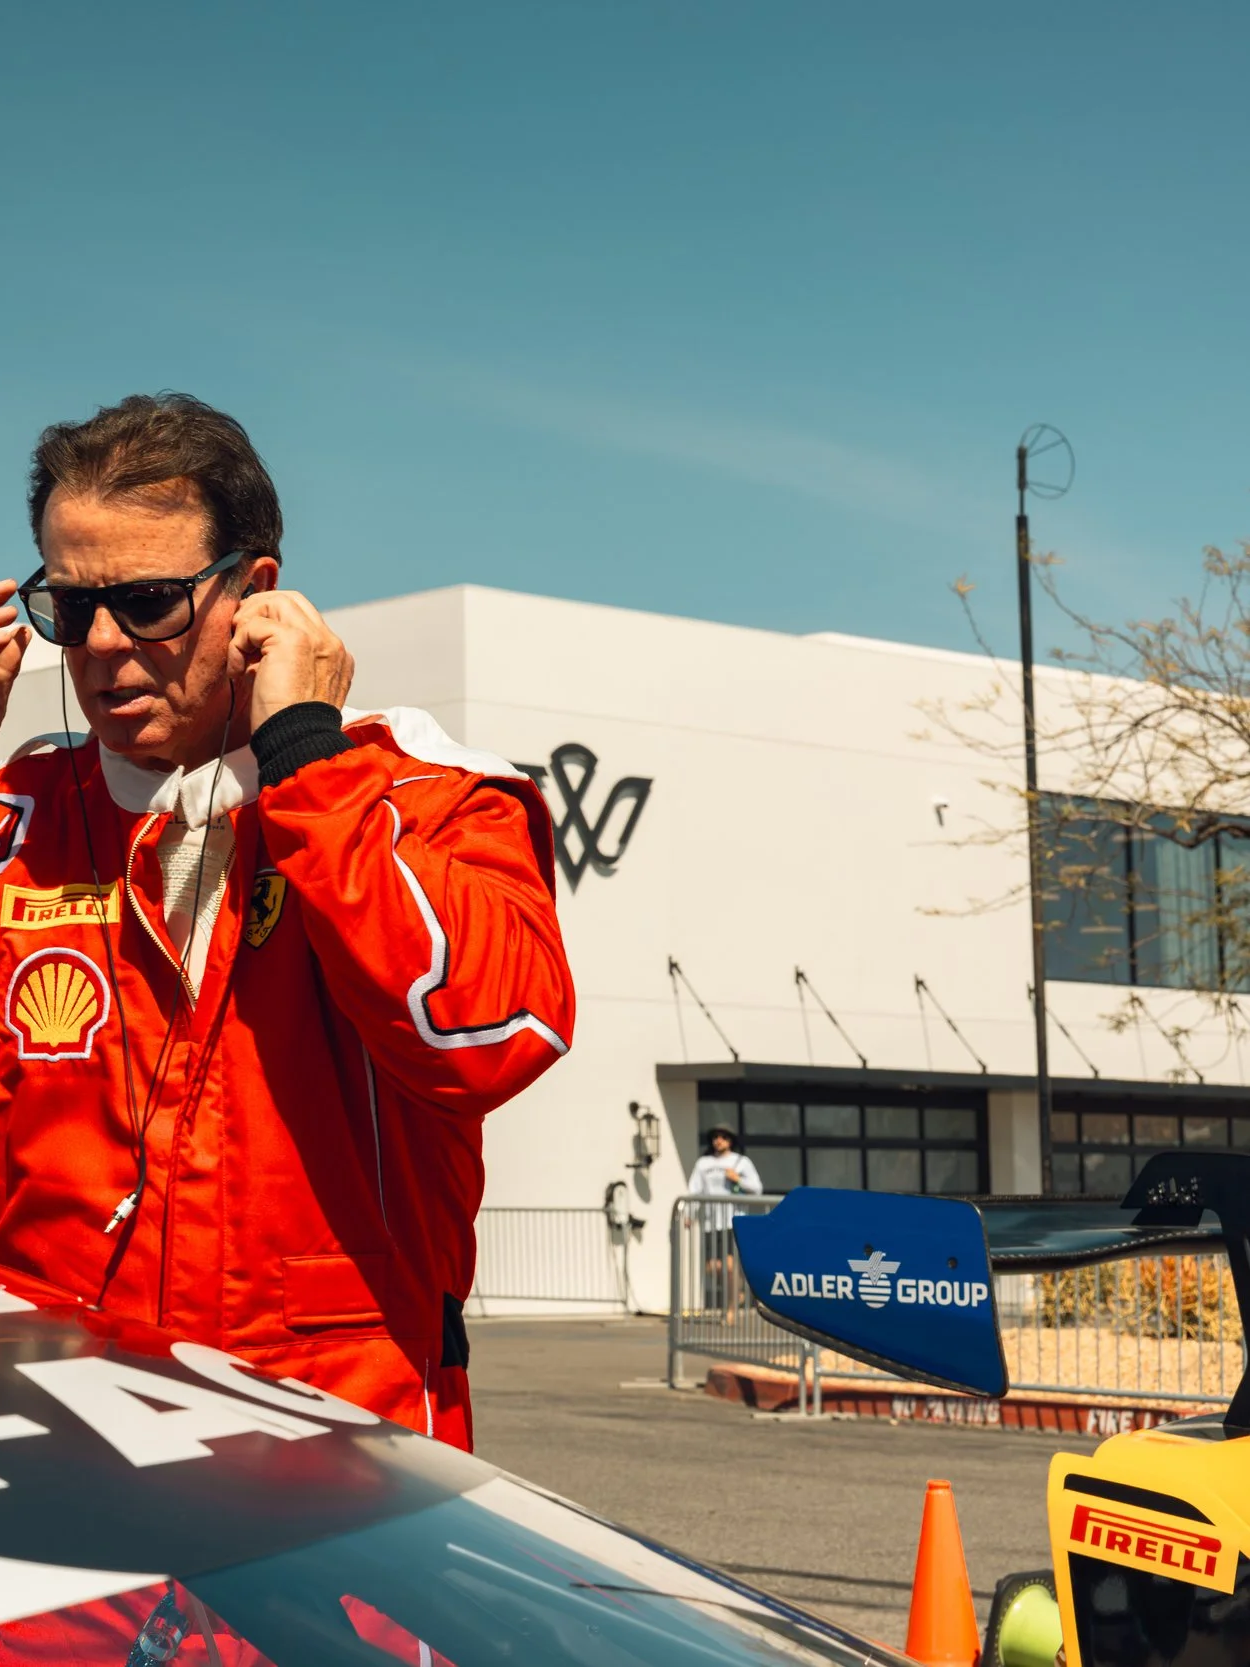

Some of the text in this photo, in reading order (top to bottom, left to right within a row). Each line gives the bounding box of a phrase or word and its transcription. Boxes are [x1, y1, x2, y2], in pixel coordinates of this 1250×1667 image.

[770, 1272, 989, 1307] ADLER GROUP
[1087, 1407, 1134, 1435] FIRE
[1070, 1504, 1222, 1577] PIRELLI
